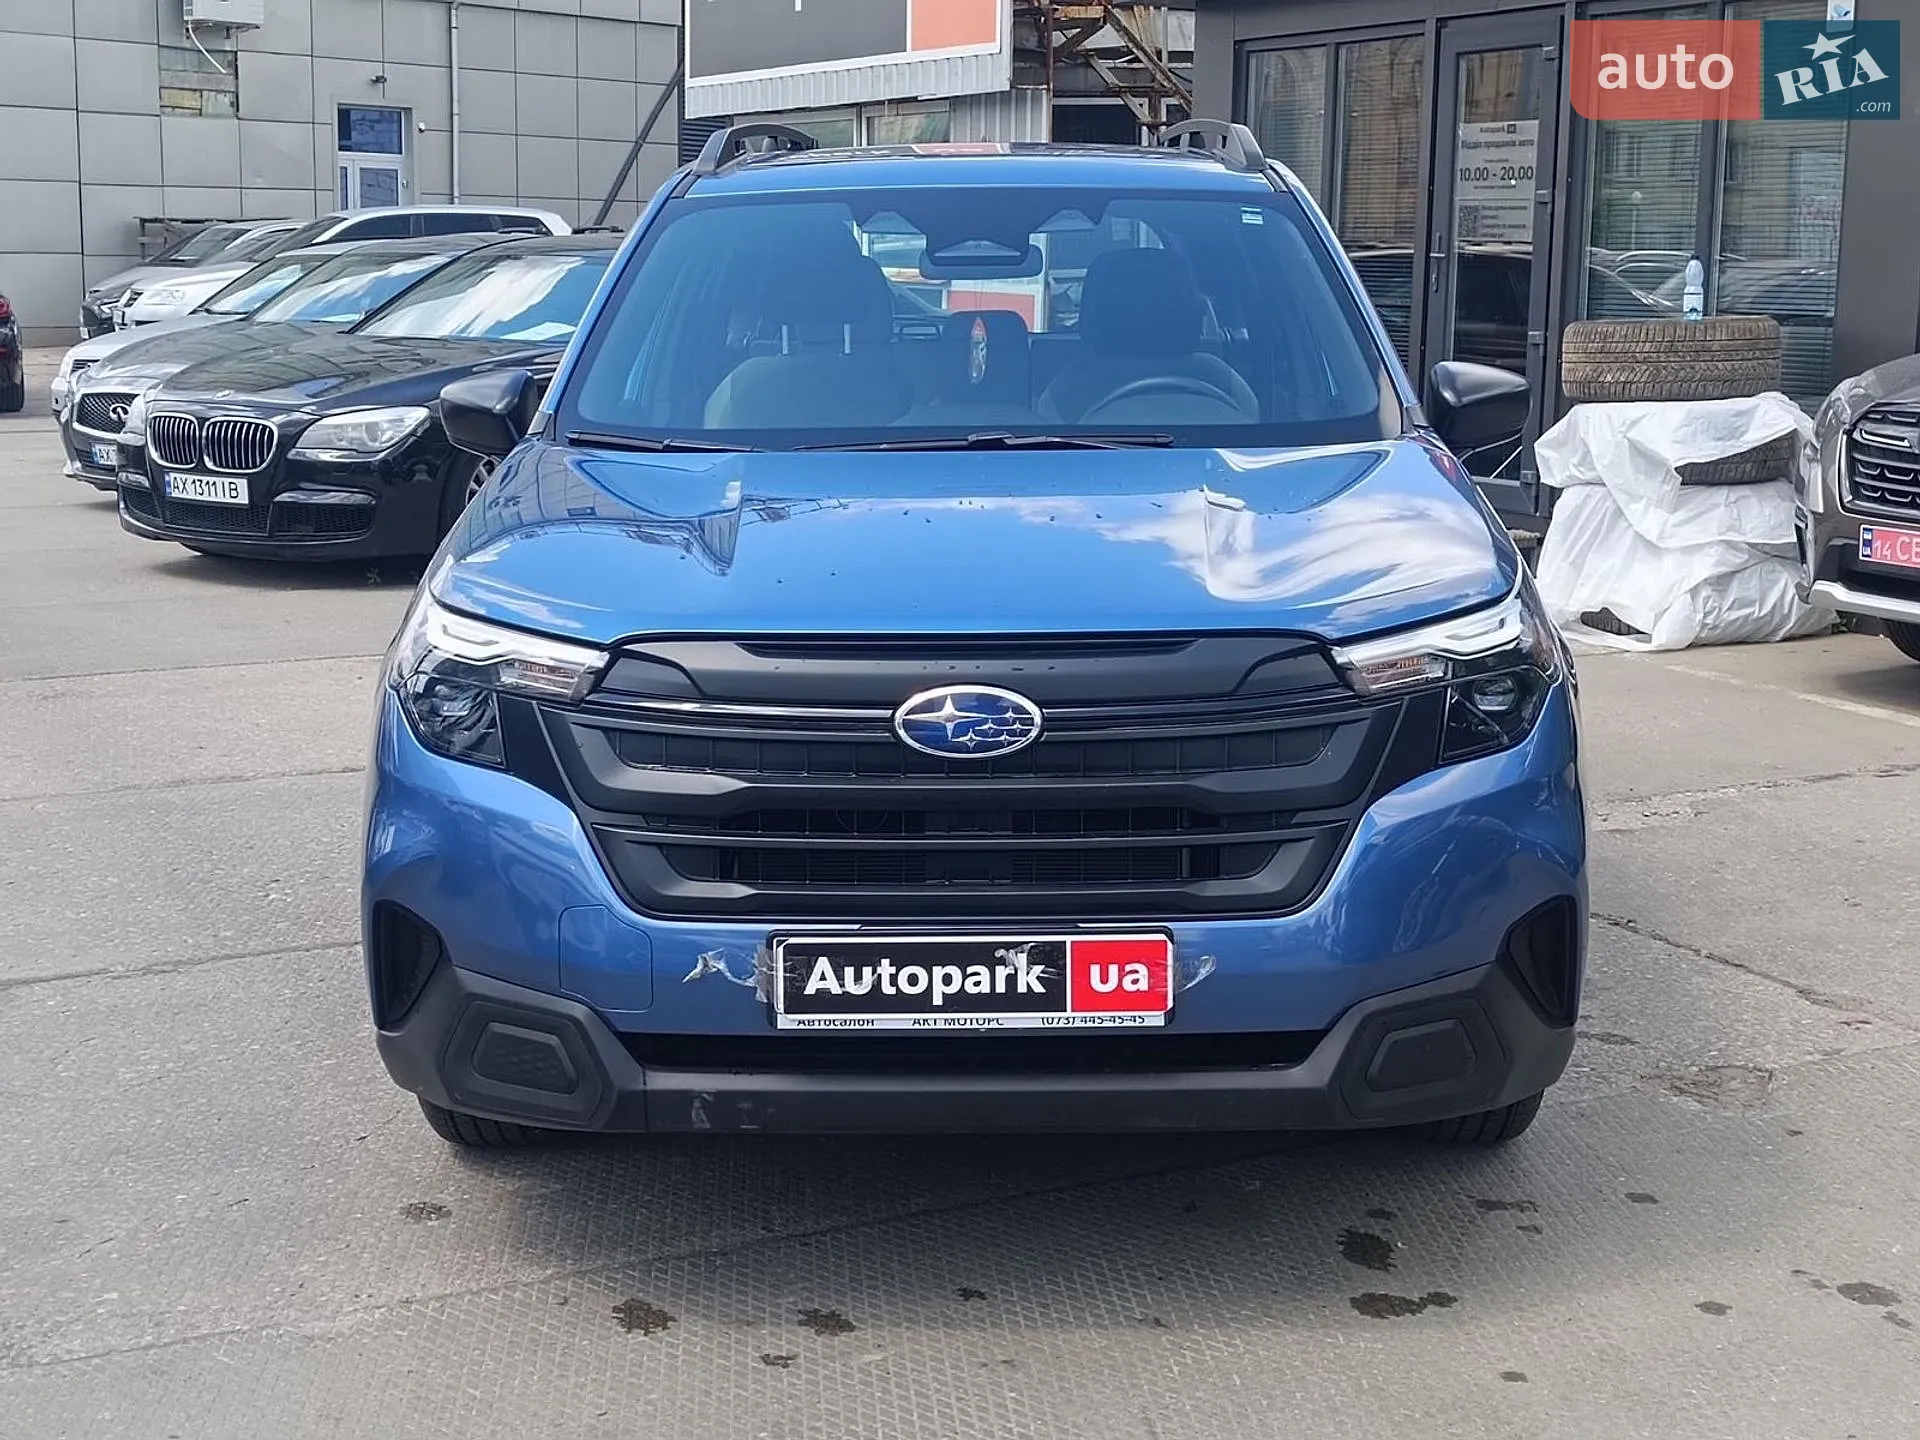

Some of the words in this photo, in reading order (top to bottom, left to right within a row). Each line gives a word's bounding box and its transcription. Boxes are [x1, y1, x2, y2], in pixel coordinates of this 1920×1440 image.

[1460, 166, 1489, 181] 10.00
[804, 951, 1046, 1006] Autopark
[1088, 962, 1149, 992] ua
